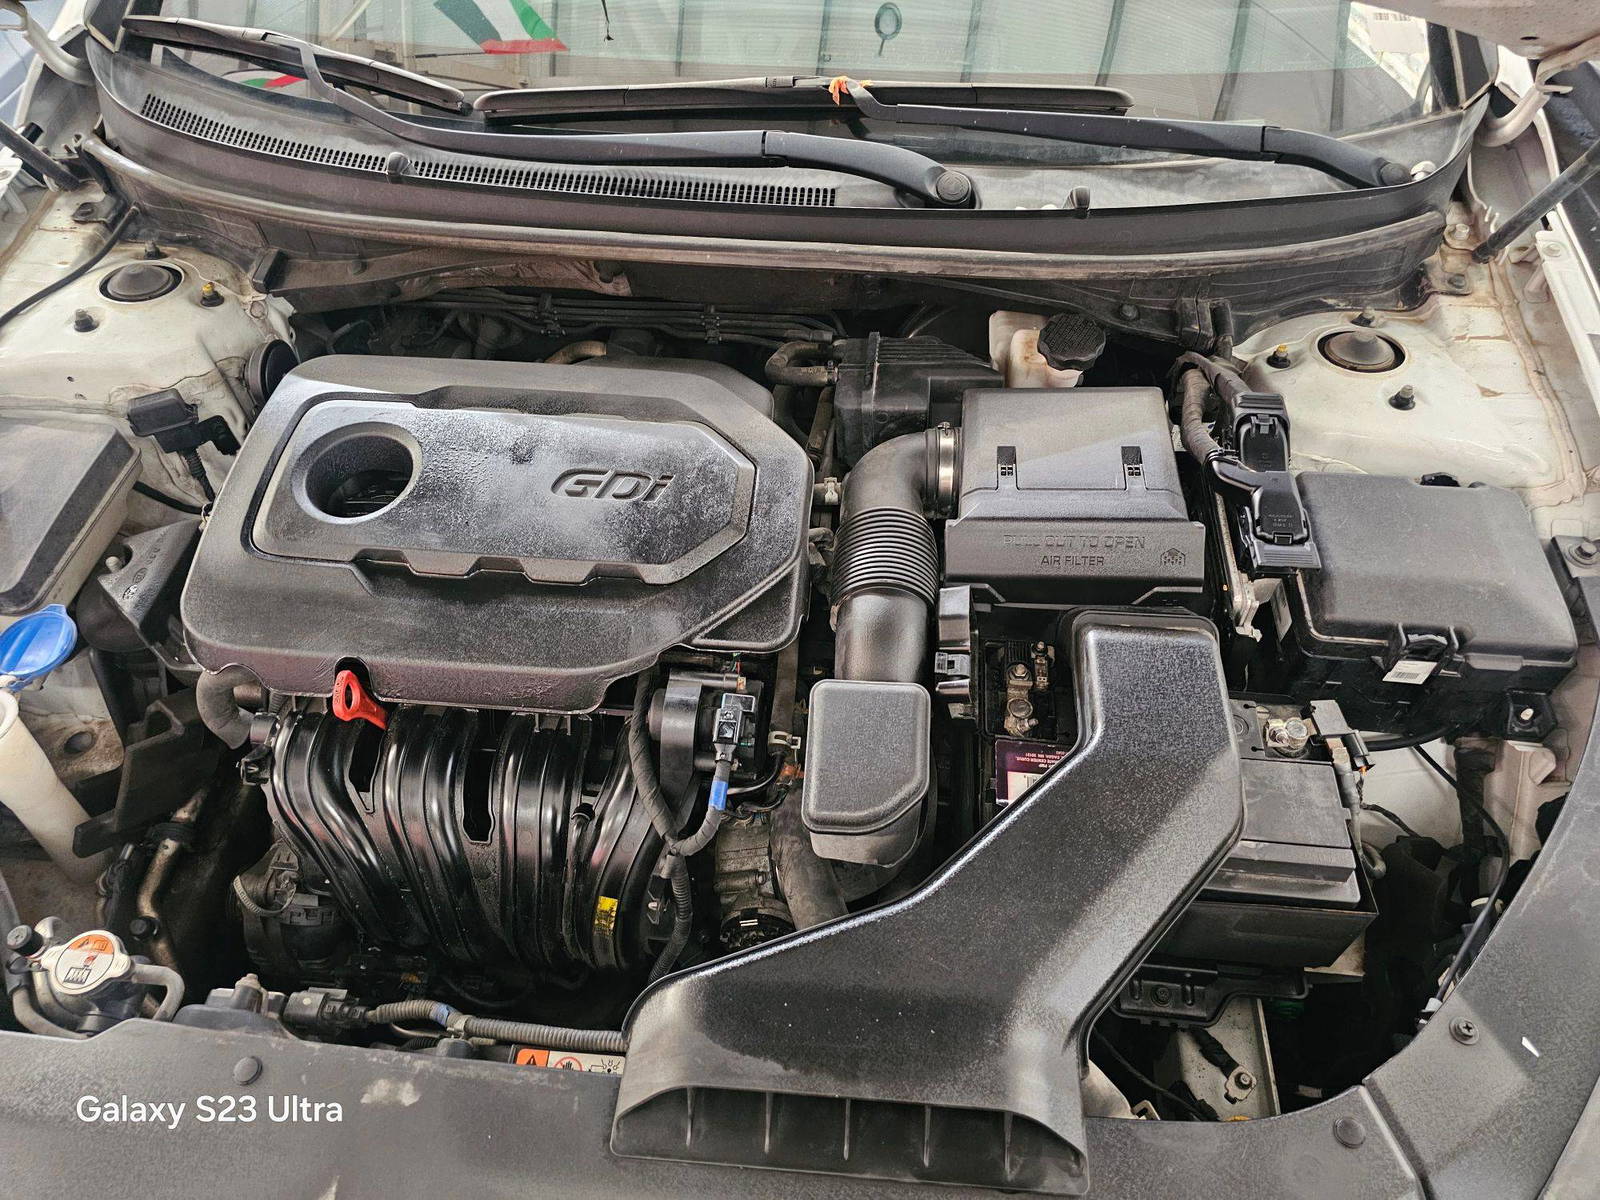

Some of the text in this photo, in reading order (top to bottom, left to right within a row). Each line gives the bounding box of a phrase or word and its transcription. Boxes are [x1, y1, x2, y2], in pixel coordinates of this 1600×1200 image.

[1003, 534, 1146, 549] PULL OUT TO OPEN
[1040, 555, 1105, 567] AIR FILTER
